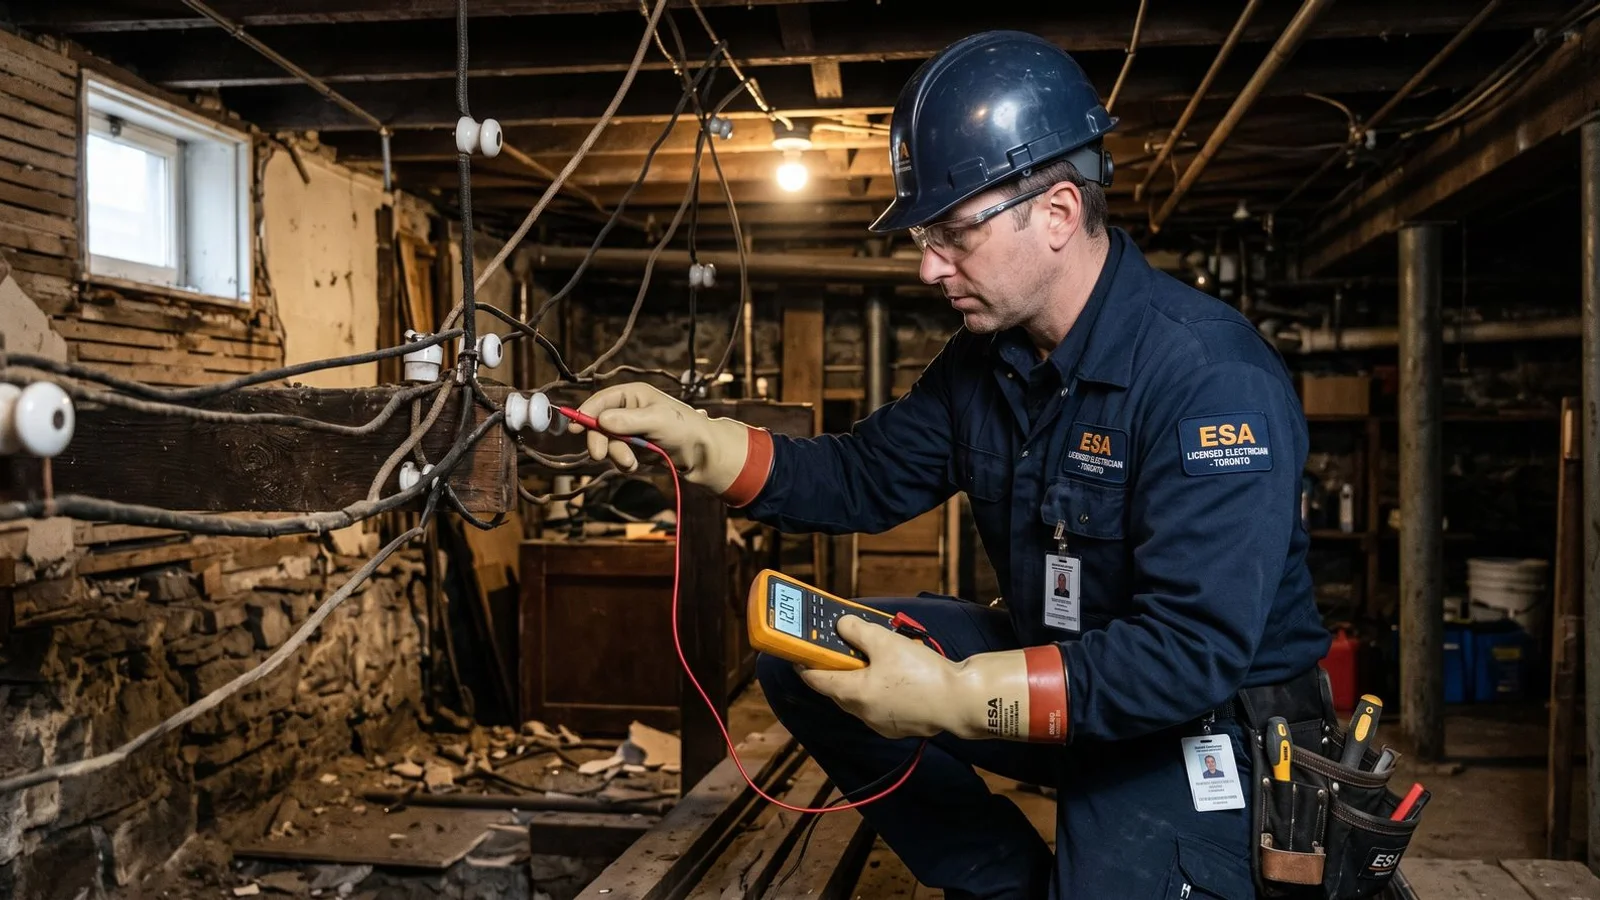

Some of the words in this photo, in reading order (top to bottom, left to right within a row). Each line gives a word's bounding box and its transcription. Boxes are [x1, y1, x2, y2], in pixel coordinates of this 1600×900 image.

[1080, 432, 1112, 456] ESA
[1199, 423, 1256, 447] ESA
[1187, 449, 1224, 460] LICENSED
[1225, 447, 1269, 457] ELECTRICIAN
[1371, 853, 1400, 867] ESA
